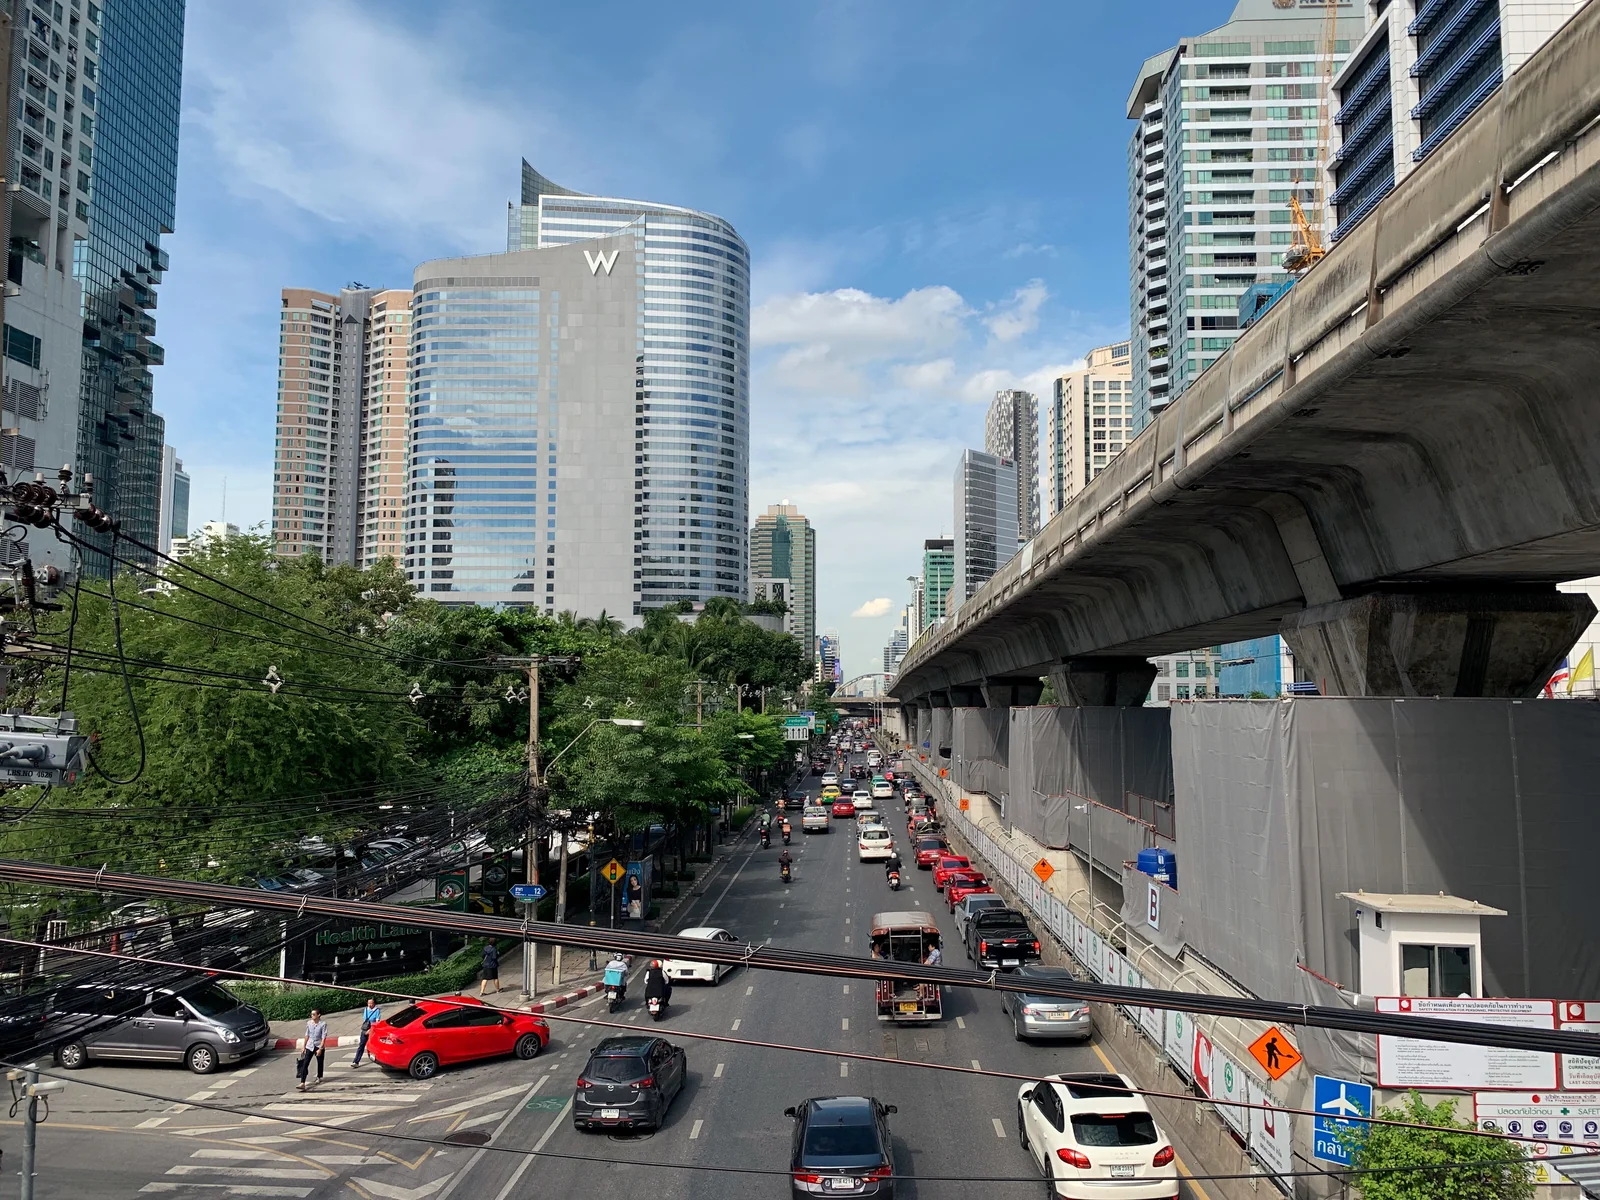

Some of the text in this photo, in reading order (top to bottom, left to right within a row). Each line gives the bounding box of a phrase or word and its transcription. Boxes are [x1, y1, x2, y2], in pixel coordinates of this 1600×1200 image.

[583, 249, 620, 276] W
[534, 887, 542, 895] 12
[1150, 888, 1157, 921] B
[315, 925, 377, 946] Health
[1497, 1107, 1553, 1115] ปลอดภัยไว้ก่อน
